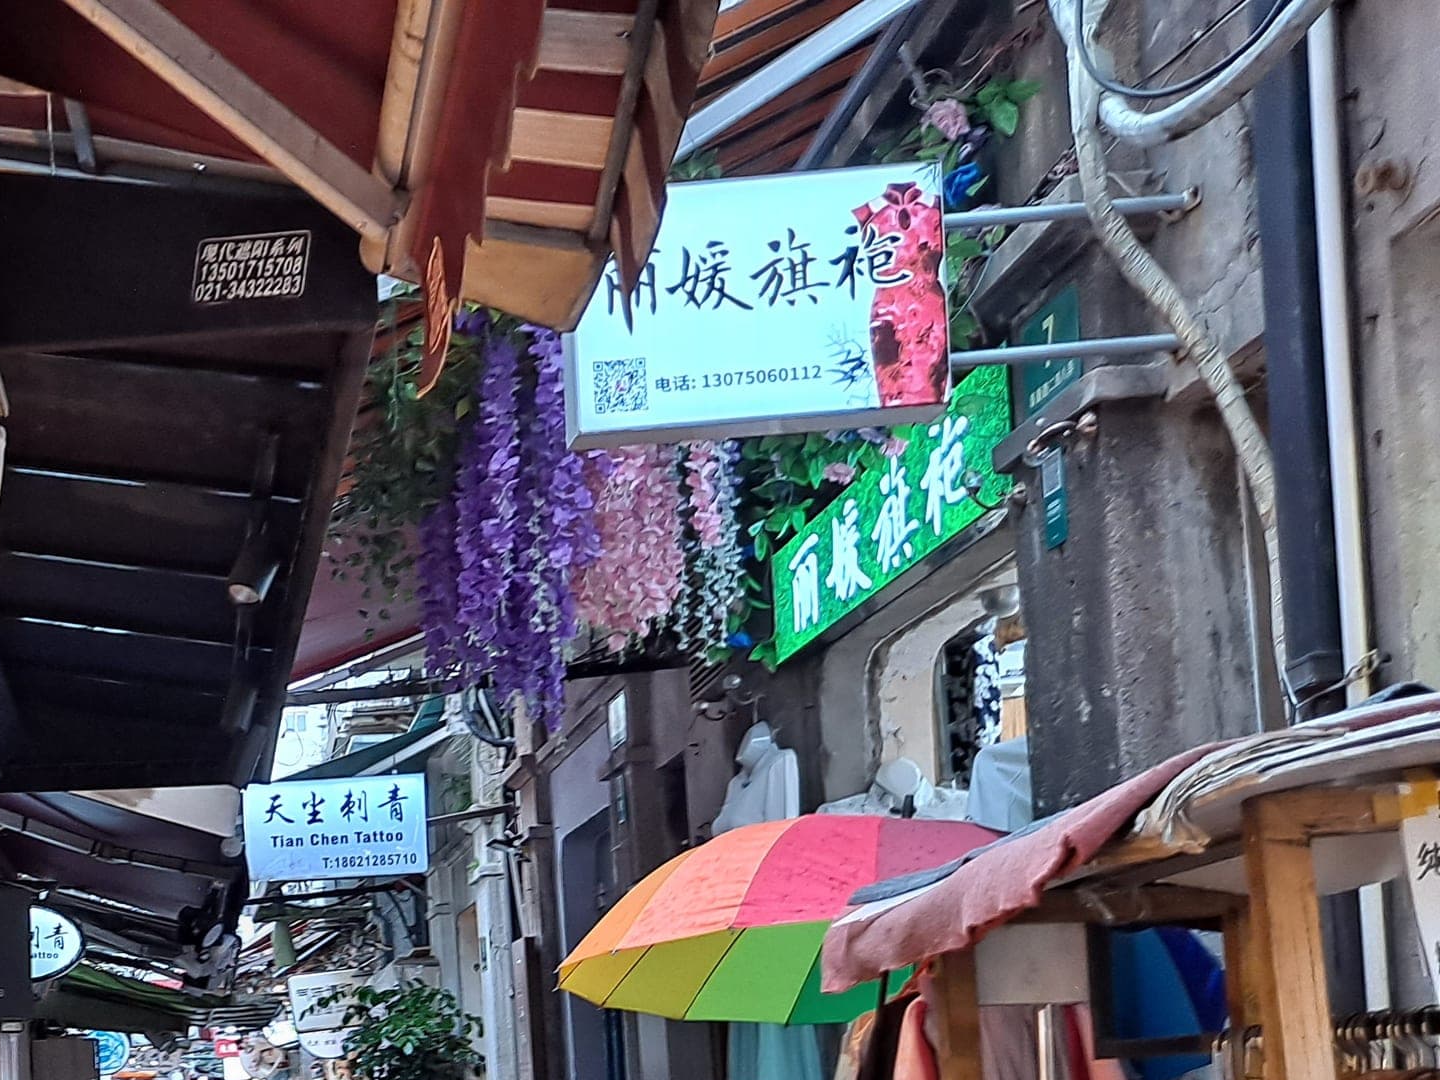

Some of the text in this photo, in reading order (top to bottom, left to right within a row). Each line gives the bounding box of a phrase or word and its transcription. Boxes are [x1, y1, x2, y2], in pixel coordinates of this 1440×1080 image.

[200, 256, 303, 283] 13501715708
[195, 275, 302, 302] 021-34322283
[789, 415, 969, 634] 丽媛旗袍
[271, 830, 403, 848] Tian Chen Tattoo
